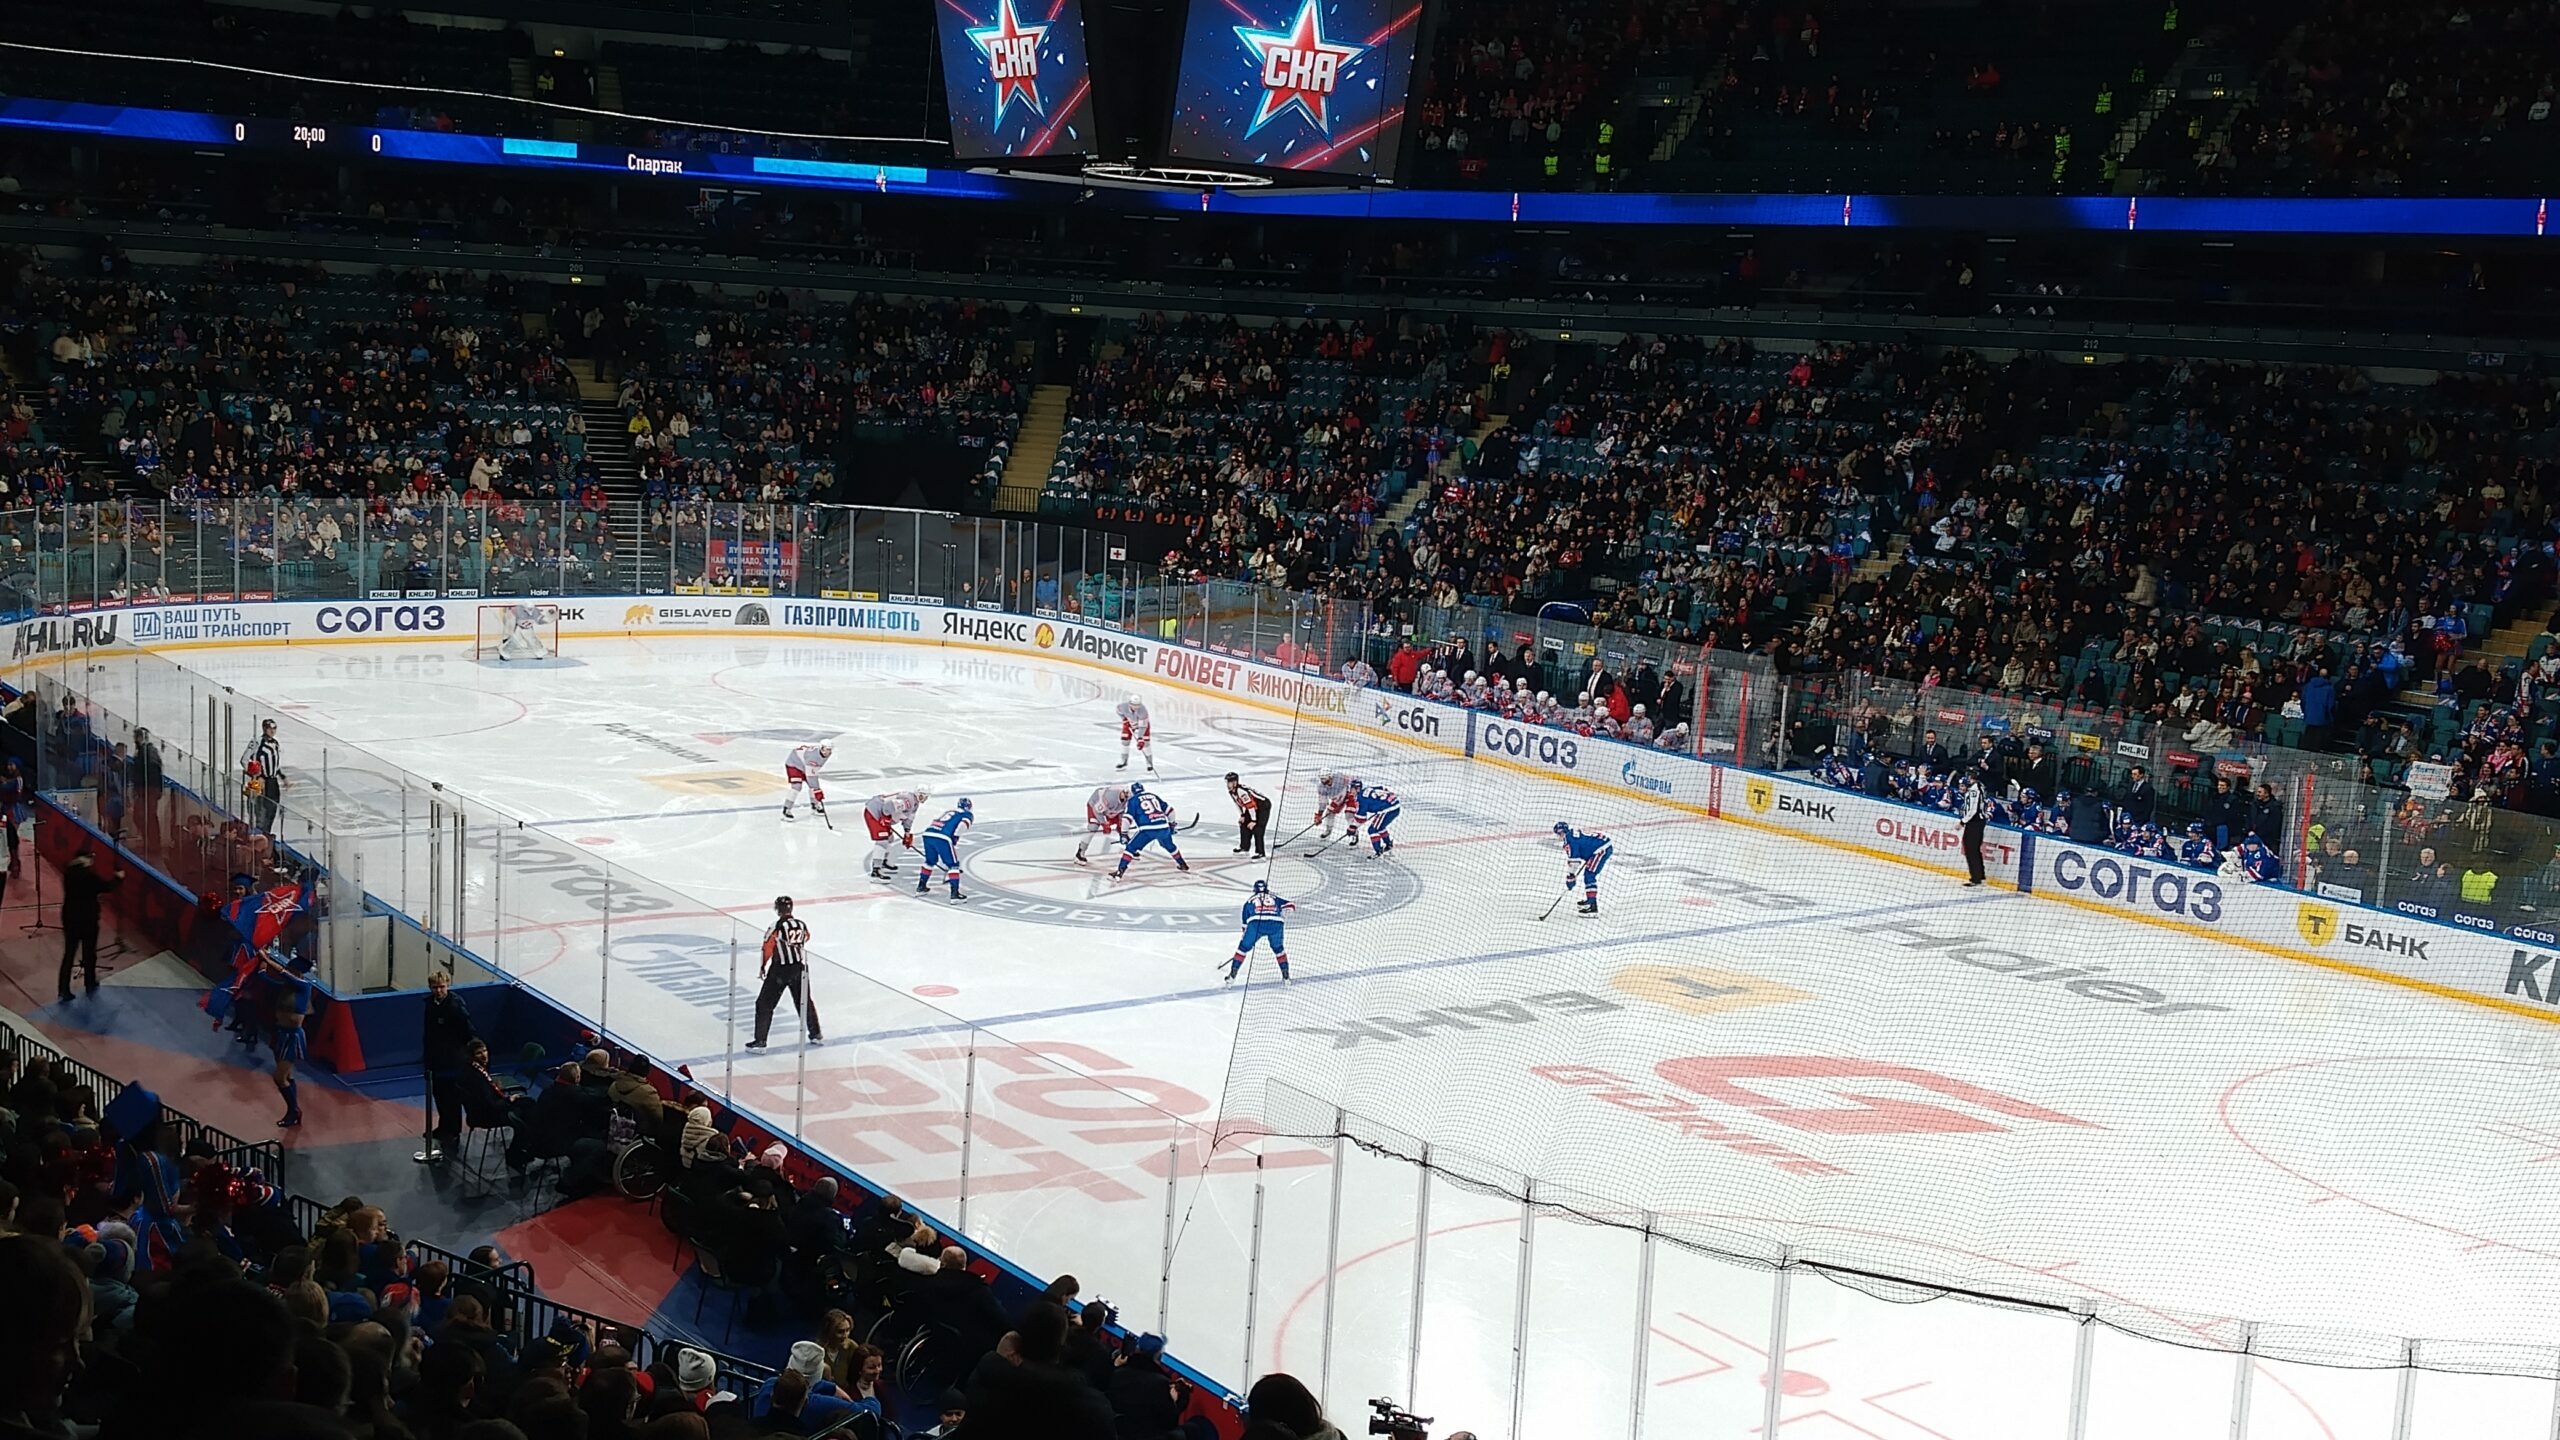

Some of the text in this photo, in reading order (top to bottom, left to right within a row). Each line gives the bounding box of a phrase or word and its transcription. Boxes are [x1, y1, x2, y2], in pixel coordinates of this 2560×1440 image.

[991, 37, 1037, 79] СКА
[1265, 46, 1338, 93] СКА
[235, 123, 245, 141] 0
[294, 126, 325, 142] 20:00
[372, 134, 381, 152] 0
[628, 153, 683, 175] Спартак
[2083, 339, 2099, 349] 212
[728, 546, 753, 554] ЛУШЕ
[530, 588, 550, 596] Haier
[164, 608, 241, 624] ВАШ ПУТЬ
[559, 608, 585, 620] НК
[659, 608, 732, 618] GISLAVED
[784, 604, 920, 632] ГАЗПРОМНЕФТЬ
[12, 614, 118, 660] KHL.RU
[164, 622, 291, 640] НАШ ТРАНСПОРТ
[942, 612, 1148, 665] Яндекс Маркет
[1154, 646, 1241, 691] FONBET
[1248, 669, 1347, 714] КИНОПОИСК
[1397, 707, 1439, 737] сбп
[2119, 744, 2147, 757] KHL.RU
[1778, 794, 1836, 823] БАНК
[1875, 816, 2016, 866] OLIMPET
[2398, 901, 2437, 918] согаз
[2454, 913, 2494, 930] согаз
[789, 929, 804, 944] 22
[2344, 923, 2430, 961] БАНК
[2513, 926, 2555, 944] согаз
[1844, 919, 2233, 1017] Haier
[1284, 990, 1626, 1050] БАНК
